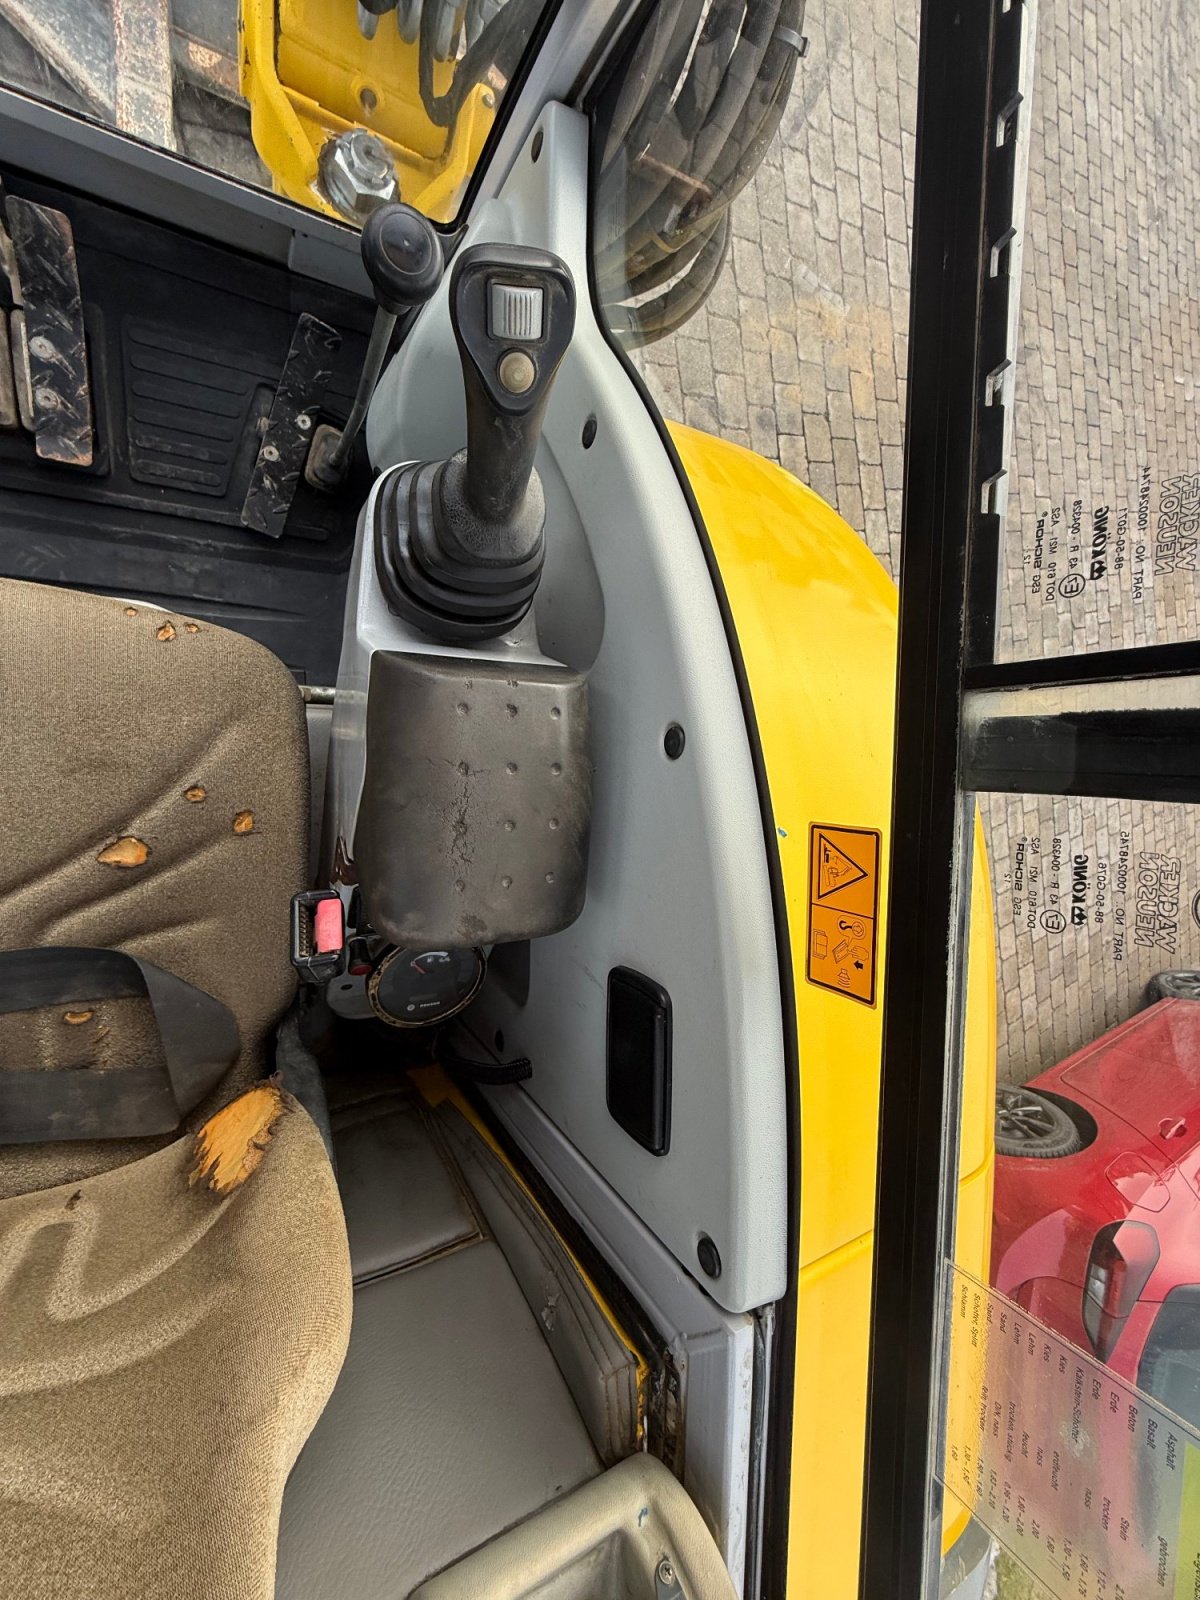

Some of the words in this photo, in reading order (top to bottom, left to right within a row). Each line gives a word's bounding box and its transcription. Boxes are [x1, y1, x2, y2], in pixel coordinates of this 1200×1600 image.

[961, 1284, 969, 1319] Schlamm
[986, 1302, 994, 1324] Sand
[1000, 1311, 1008, 1334] Sand
[1013, 1322, 1022, 1345] Lehm
[1027, 1331, 1037, 1356] Lehm
[1043, 1343, 1052, 1363] Kies
[1058, 1353, 1068, 1375] Kies
[1091, 1378, 1102, 1401] Erde
[1071, 1366, 1085, 1444] Kalkstein-Schotter
[1109, 1391, 1120, 1414] Erde
[992, 1420, 1000, 1438] nass
[1127, 1404, 1139, 1433] Beton
[1021, 1430, 1030, 1459] feucht
[1146, 1418, 1158, 1450] Basalt
[1036, 1446, 1044, 1467] nass
[1165, 1431, 1179, 1471] Asphalt
[1050, 1450, 1061, 1492] erdfeucht
[1084, 1487, 1093, 1510] nass
[1101, 1496, 1112, 1531] trocken
[1119, 1516, 1131, 1542] Stein
[1157, 1535, 1170, 1588] gebrochen
